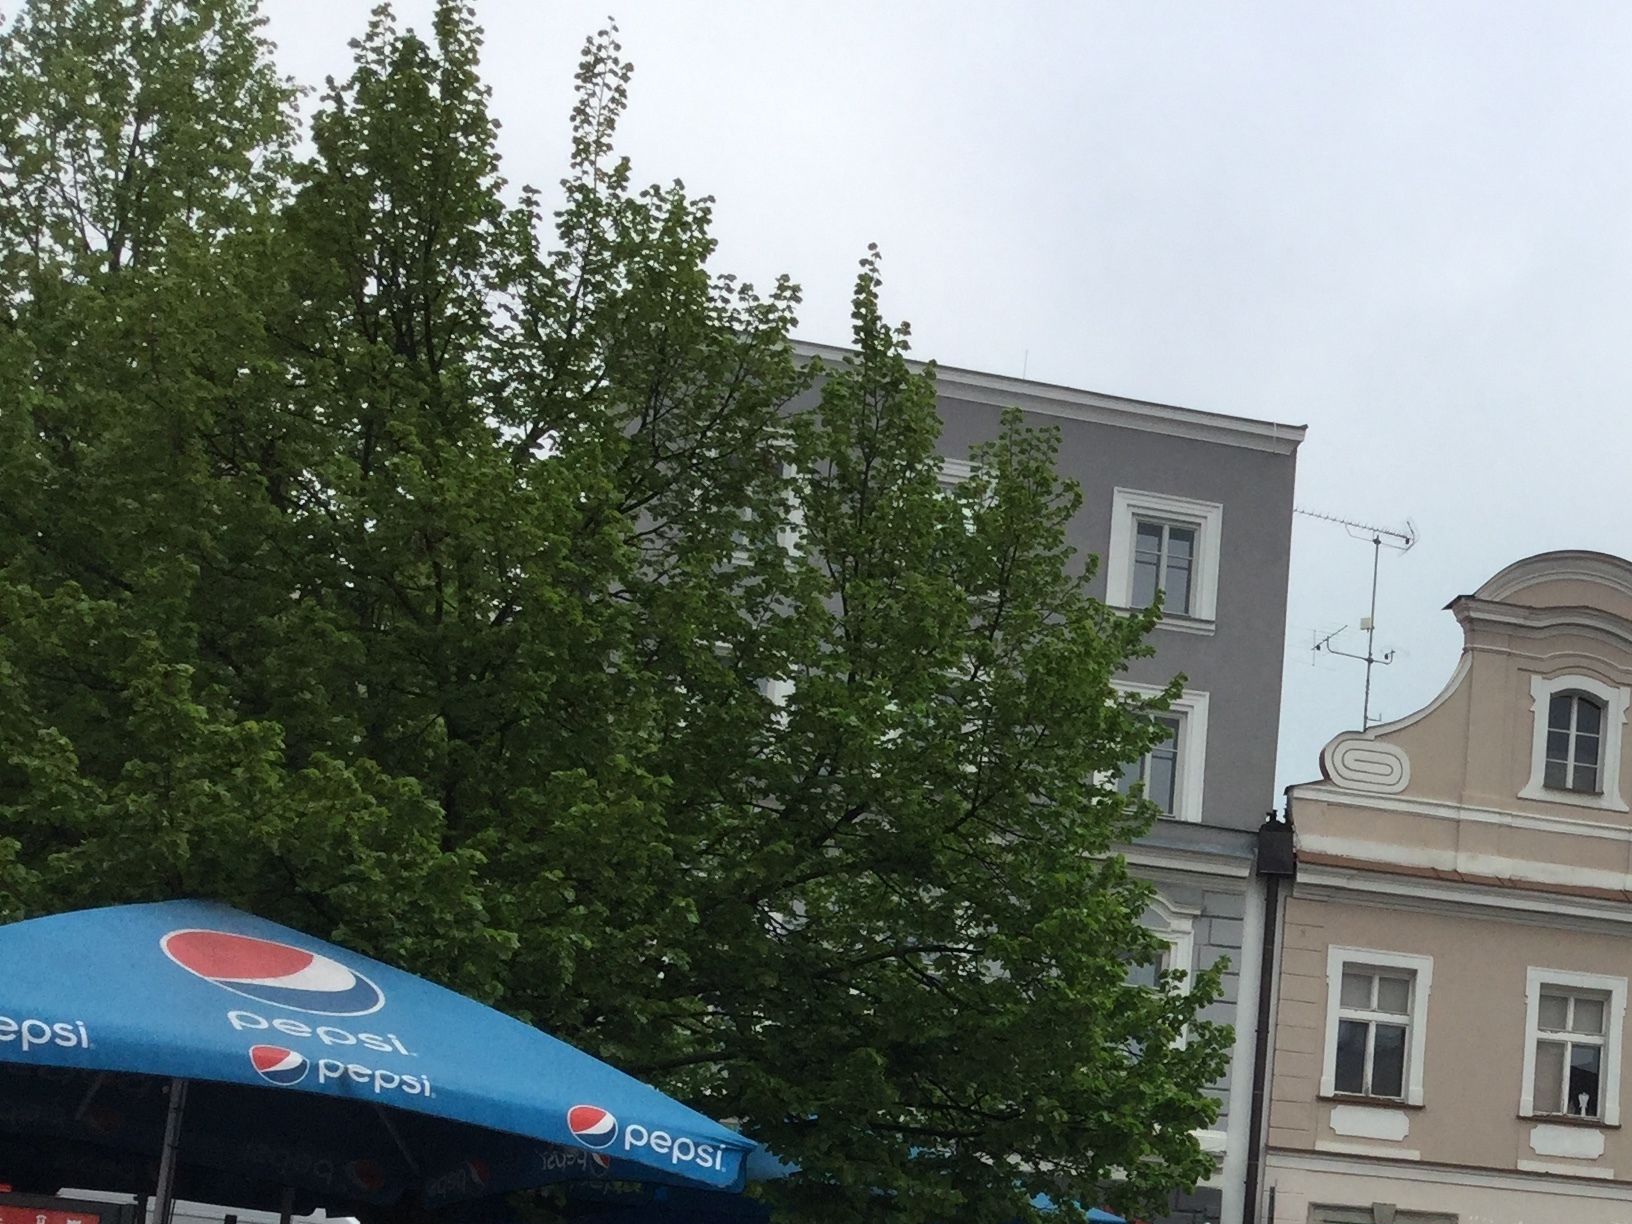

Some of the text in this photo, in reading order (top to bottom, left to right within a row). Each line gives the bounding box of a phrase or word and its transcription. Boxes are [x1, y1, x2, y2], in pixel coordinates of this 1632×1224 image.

[226, 1010, 411, 1056] pepsi
[318, 1059, 432, 1097] pepsi
[624, 1124, 724, 1171] pepsi
